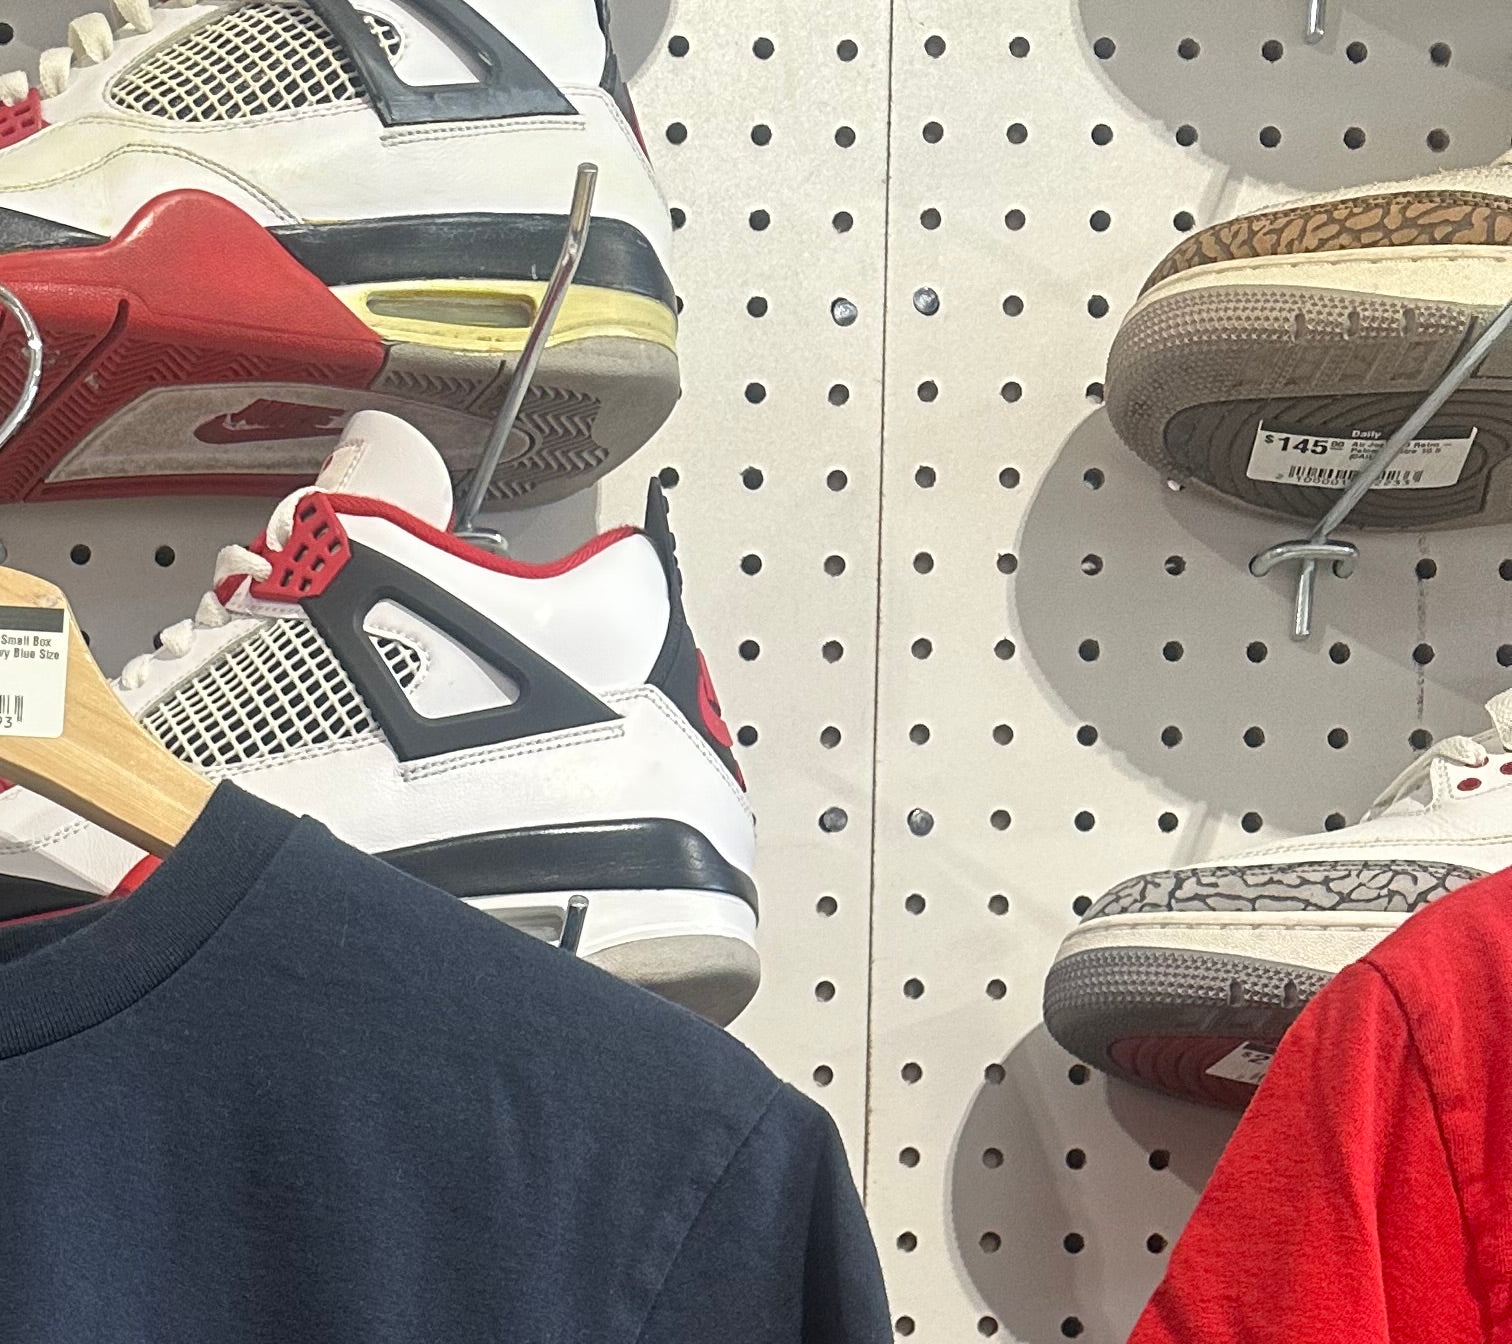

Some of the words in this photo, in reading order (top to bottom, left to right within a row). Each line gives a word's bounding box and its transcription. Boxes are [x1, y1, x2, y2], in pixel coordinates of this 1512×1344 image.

[1351, 429, 1382, 439] Daily
[0, 633, 31, 647] Small
[32, 635, 52, 648] Box
[13, 647, 36, 660] Blue
[39, 648, 60, 661] Size
